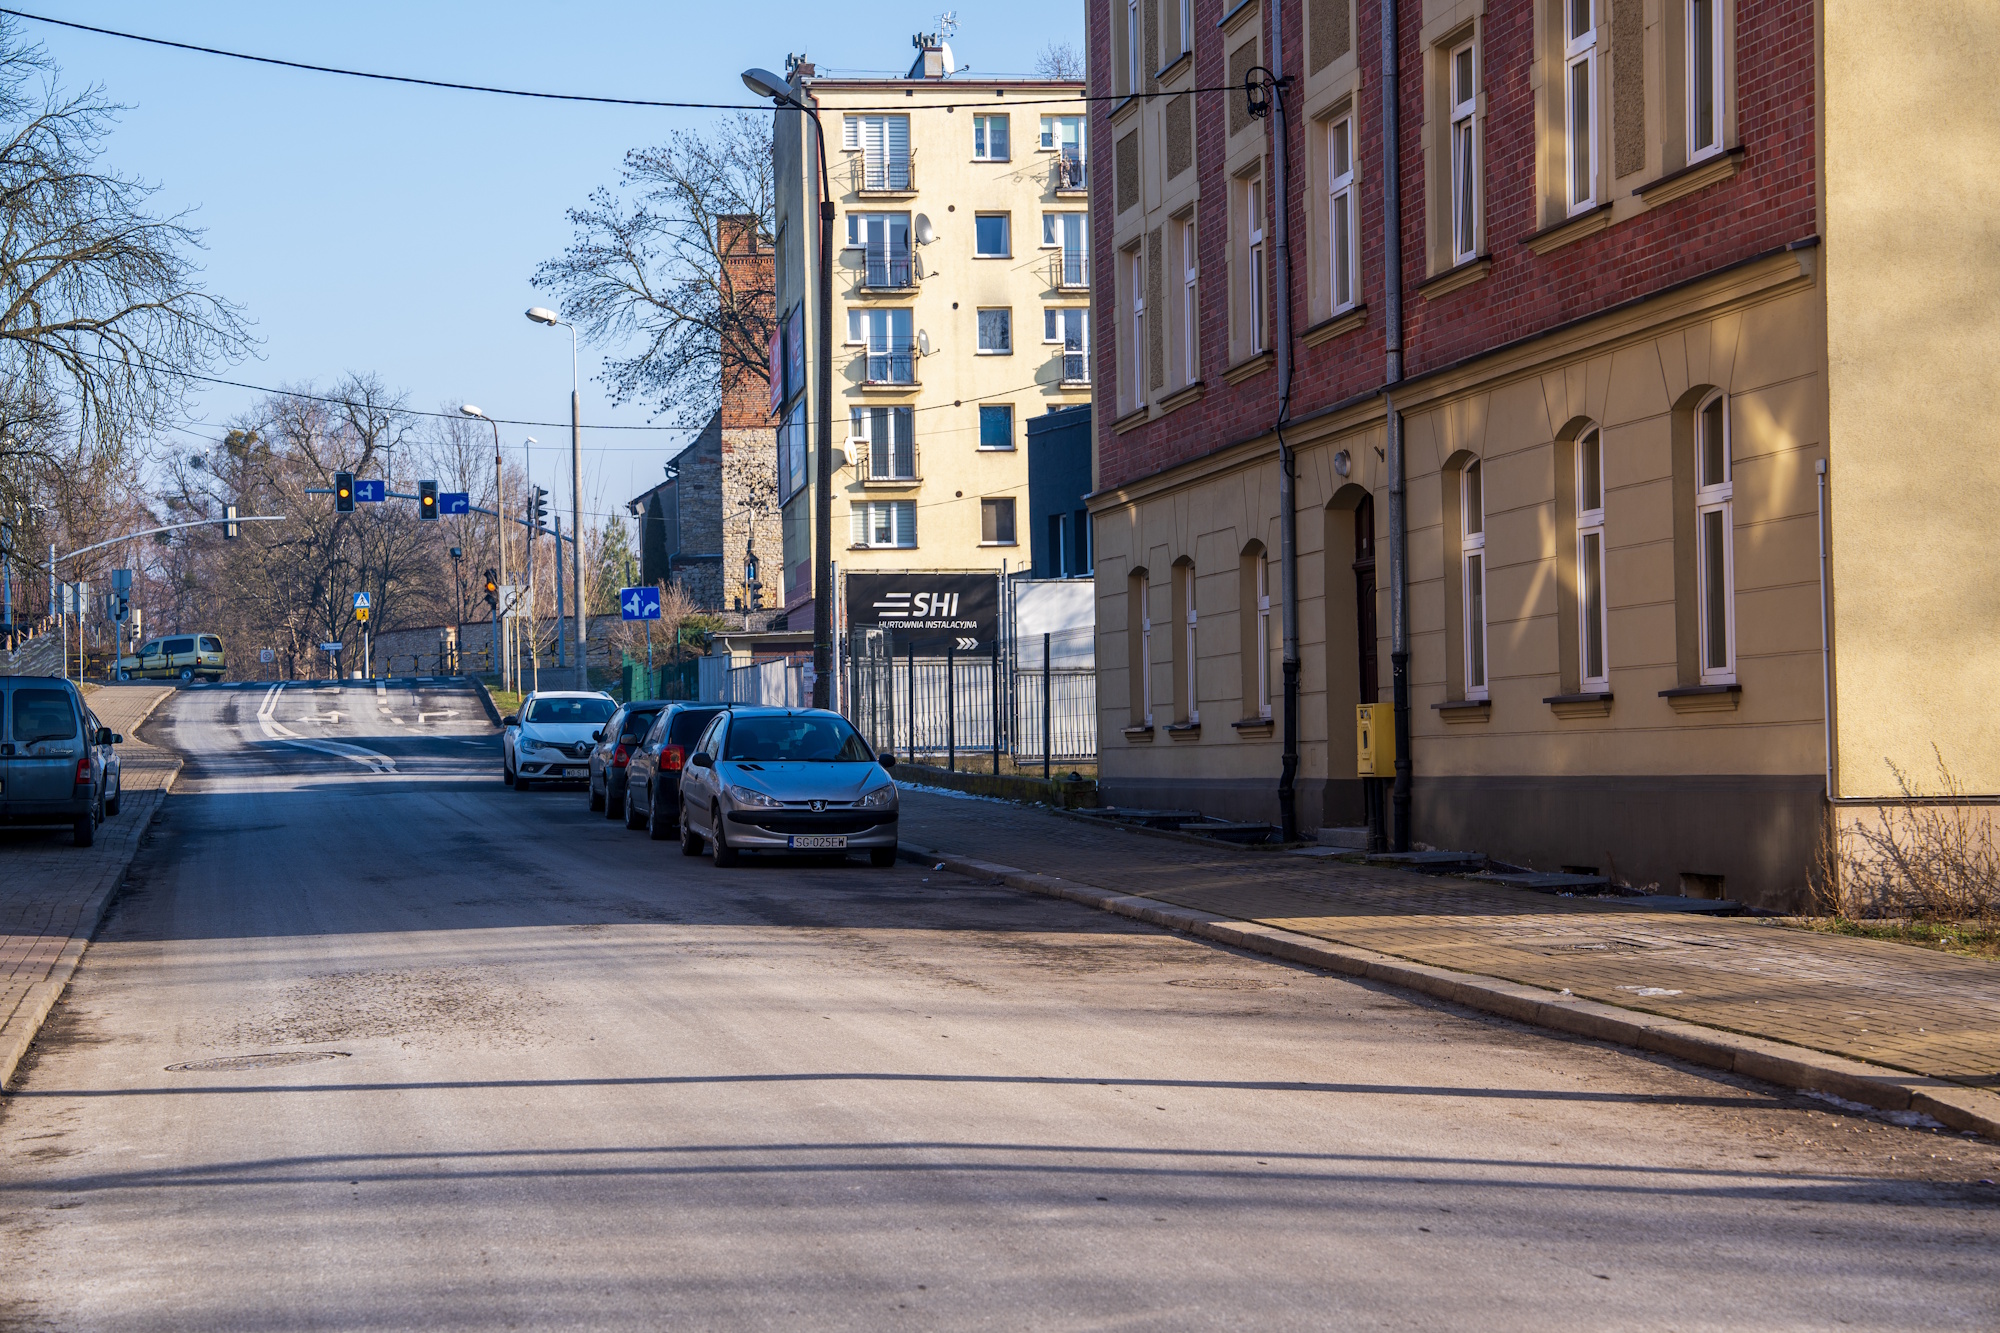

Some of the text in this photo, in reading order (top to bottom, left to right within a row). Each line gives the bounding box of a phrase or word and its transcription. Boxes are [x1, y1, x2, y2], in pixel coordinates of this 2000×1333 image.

[878, 620, 978, 630] HURTOWNIA INSTALACYJNA
[796, 837, 810, 847] SG
